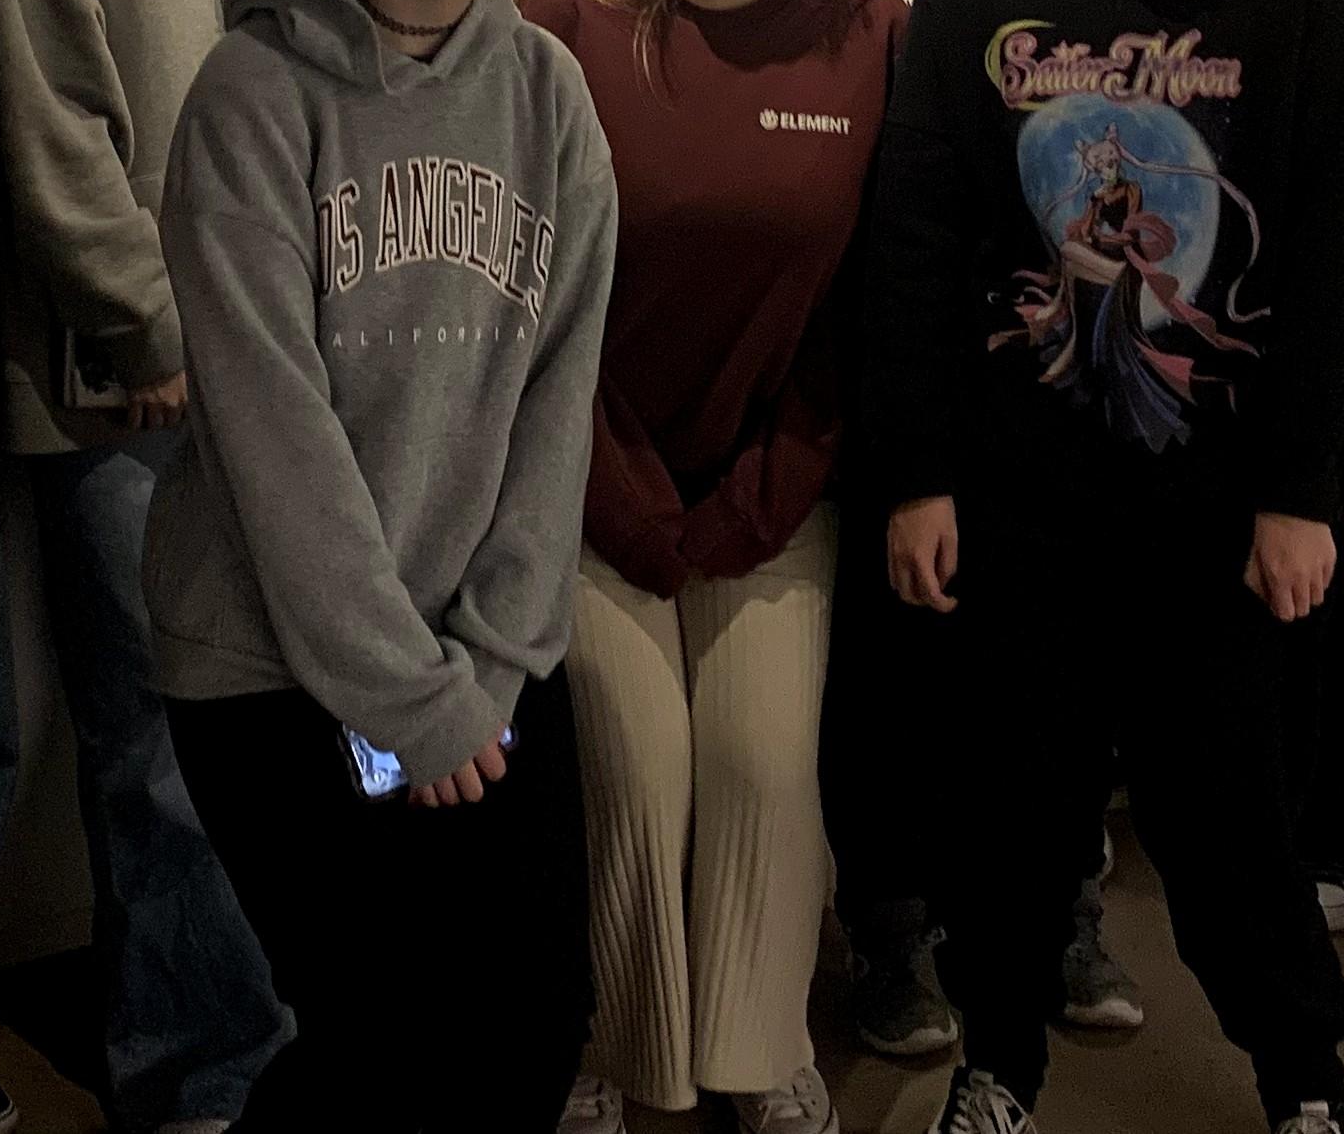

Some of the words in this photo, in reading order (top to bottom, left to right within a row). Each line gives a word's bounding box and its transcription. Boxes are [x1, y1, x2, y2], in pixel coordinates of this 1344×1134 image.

[1102, 28, 1243, 108] Moon
[780, 112, 851, 135] ELEMENT
[374, 156, 555, 325] ANGELES
